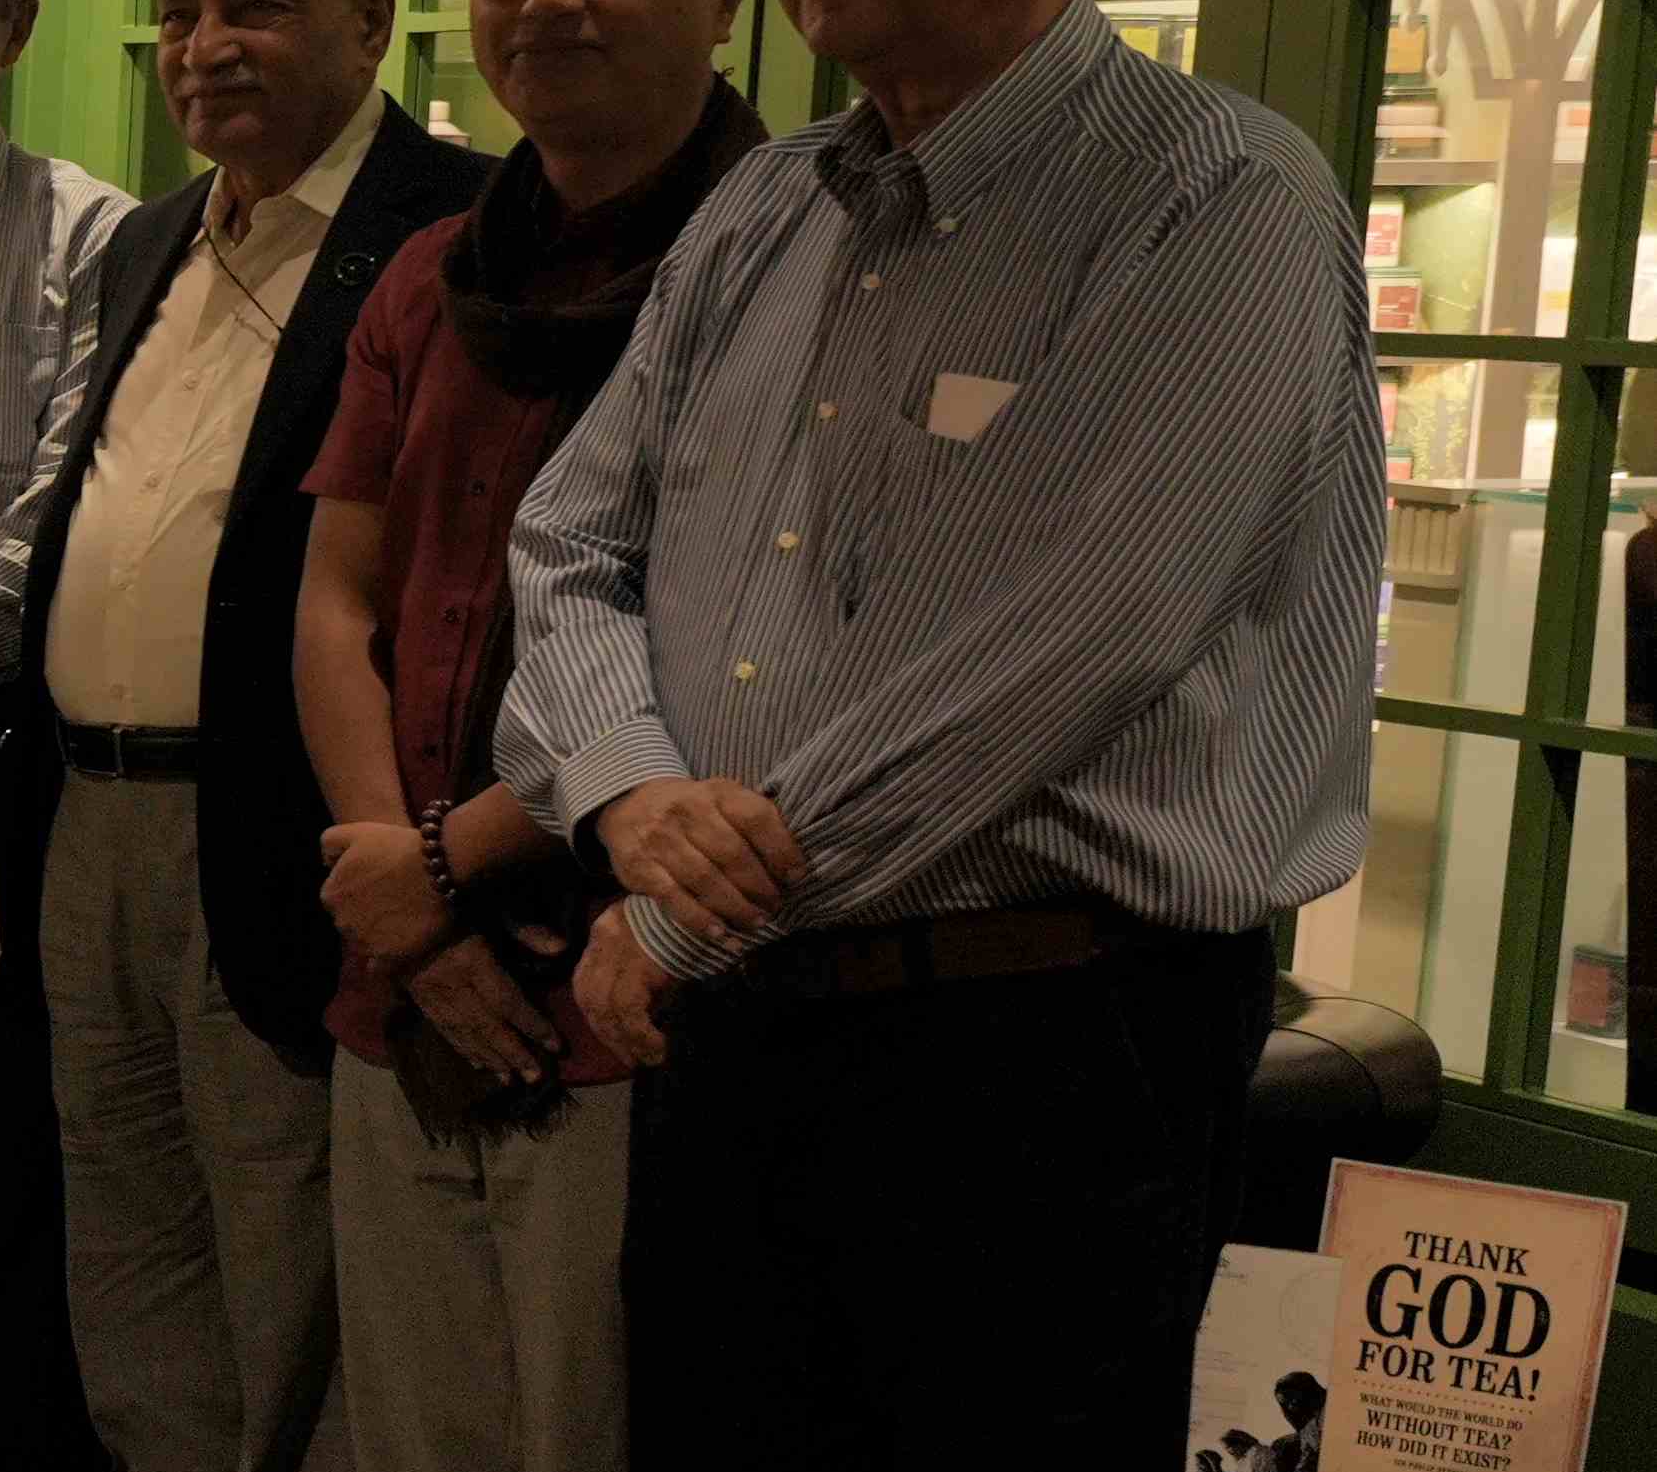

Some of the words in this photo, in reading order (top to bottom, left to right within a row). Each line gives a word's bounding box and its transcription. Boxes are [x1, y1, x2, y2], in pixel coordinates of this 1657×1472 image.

[1404, 1230, 1530, 1277] THANK
[1365, 1263, 1552, 1360] GOD
[1355, 1339, 1436, 1384] FOR
[1446, 1355, 1542, 1402] TEA!
[1359, 1391, 1394, 1411] WHAT
[1395, 1398, 1437, 1418] WOULD
[1438, 1405, 1461, 1421] THE
[1463, 1410, 1505, 1429] WORLD
[1505, 1418, 1523, 1431] DO
[1366, 1408, 1459, 1443] WITHOUT
[1462, 1427, 1513, 1451] TEA?
[1356, 1429, 1395, 1450] HOW
[1398, 1437, 1428, 1457] DID
[1430, 1444, 1449, 1461] IT
[1452, 1448, 1512, 1472] EXIST?
